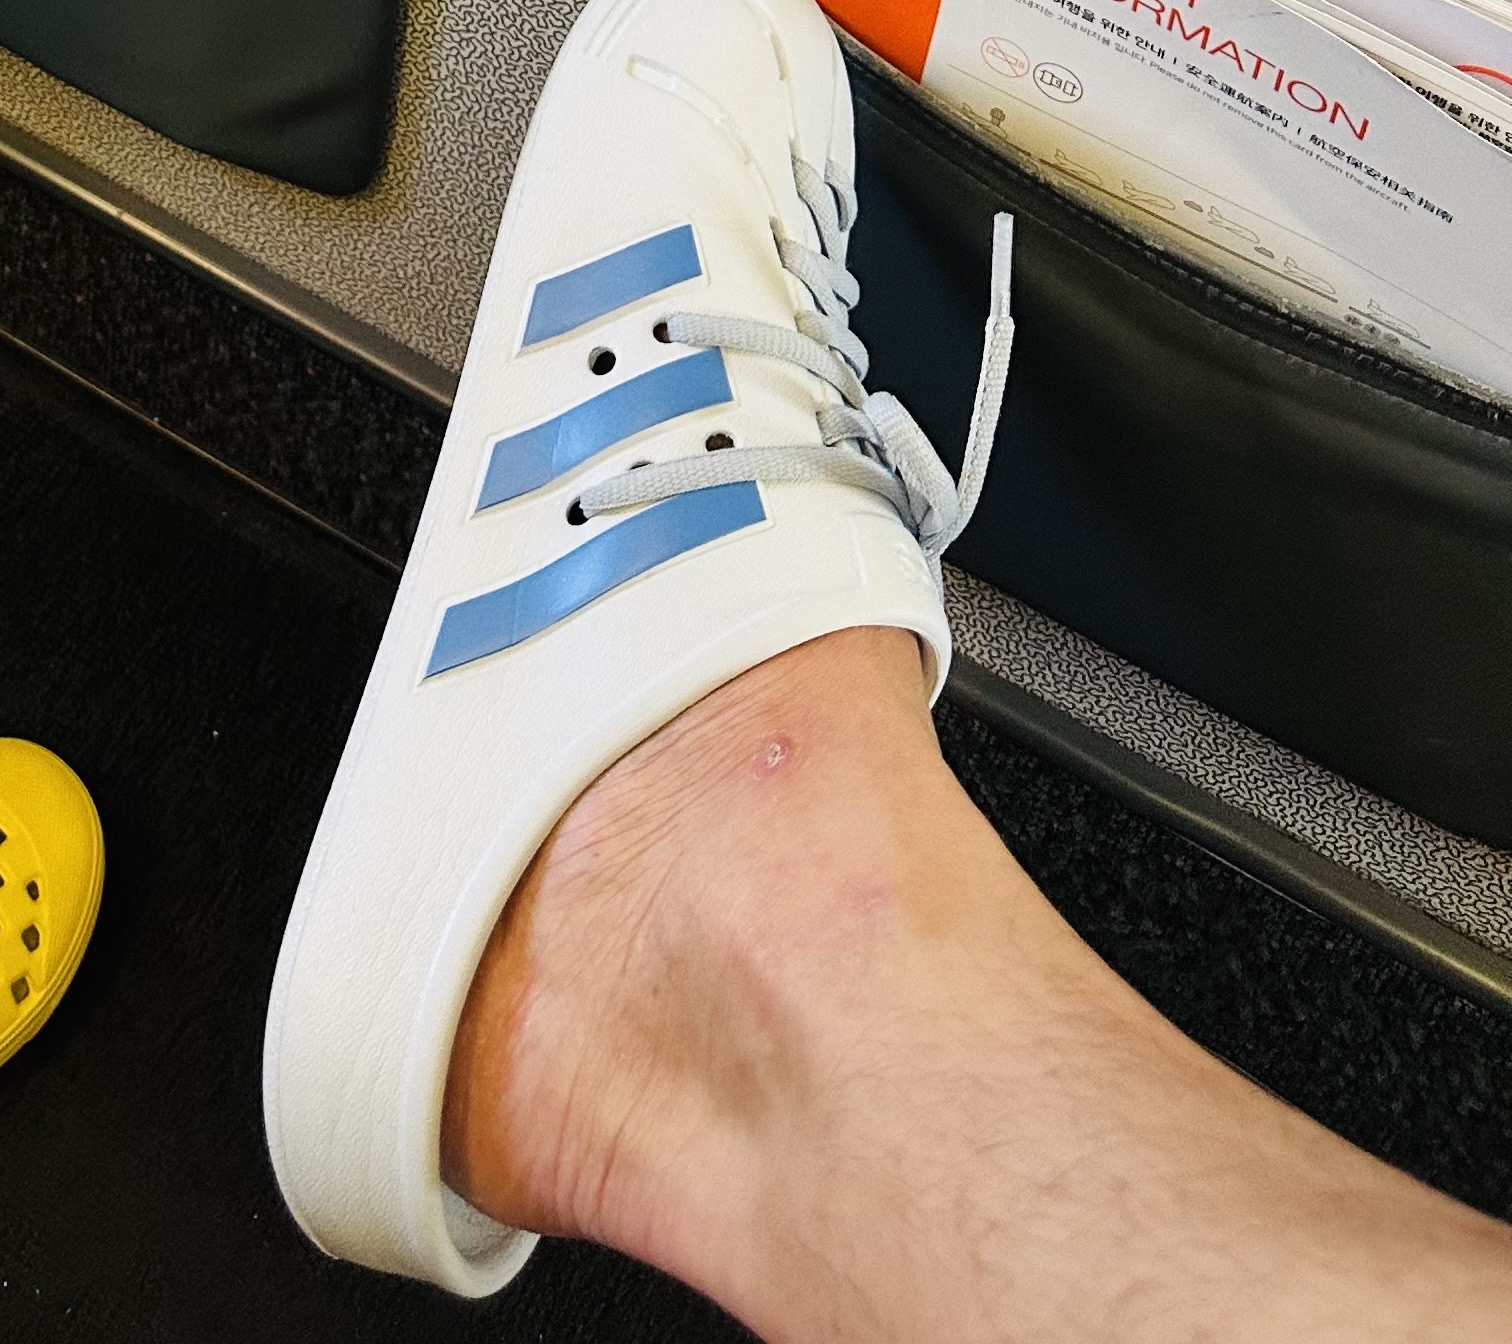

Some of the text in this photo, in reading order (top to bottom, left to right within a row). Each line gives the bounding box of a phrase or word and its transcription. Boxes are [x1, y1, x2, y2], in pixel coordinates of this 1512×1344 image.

[1099, 17, 1131, 41] 위한
[1134, 35, 1167, 60] 안내
[1149, 61, 1185, 84] Please
[1186, 80, 1201, 94] do
[1202, 89, 1221, 104] not
[1222, 101, 1264, 128] remove
[1266, 125, 1287, 142] this
[1288, 139, 1313, 157] card
[1315, 154, 1343, 174] from
[1345, 170, 1365, 186] the
